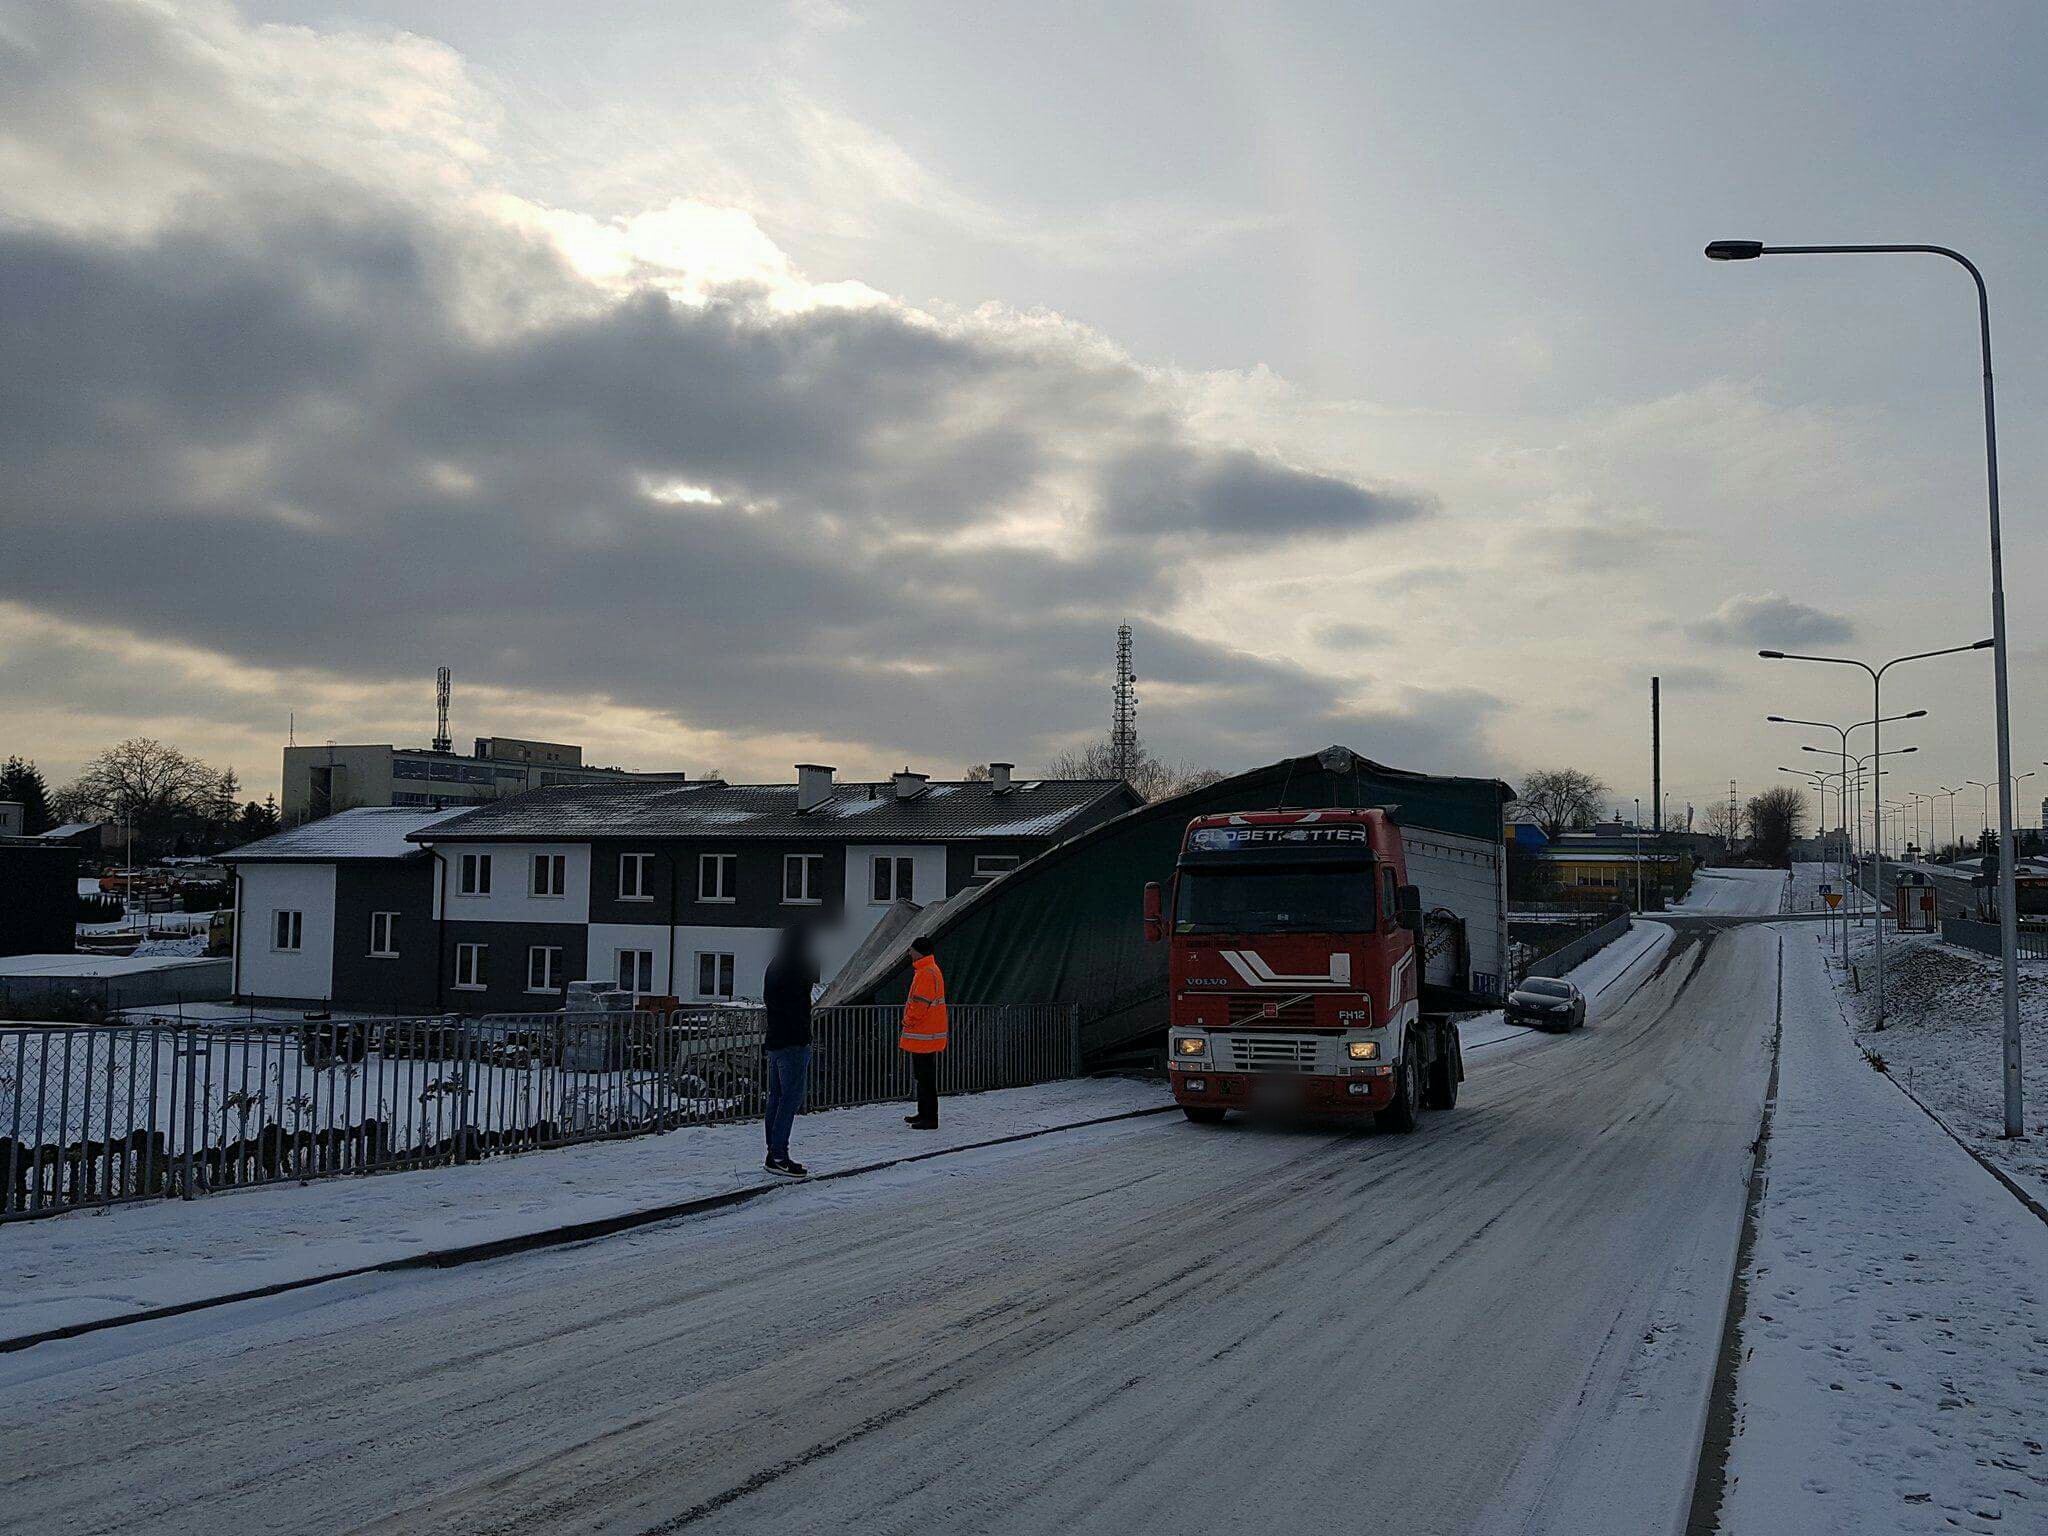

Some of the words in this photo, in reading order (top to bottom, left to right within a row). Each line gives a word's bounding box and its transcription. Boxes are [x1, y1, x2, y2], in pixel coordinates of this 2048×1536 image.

[1195, 829, 1366, 843] GLOBETTTER
[1186, 978, 1228, 986] VOLVO
[1339, 1010, 1366, 1020] FH12
